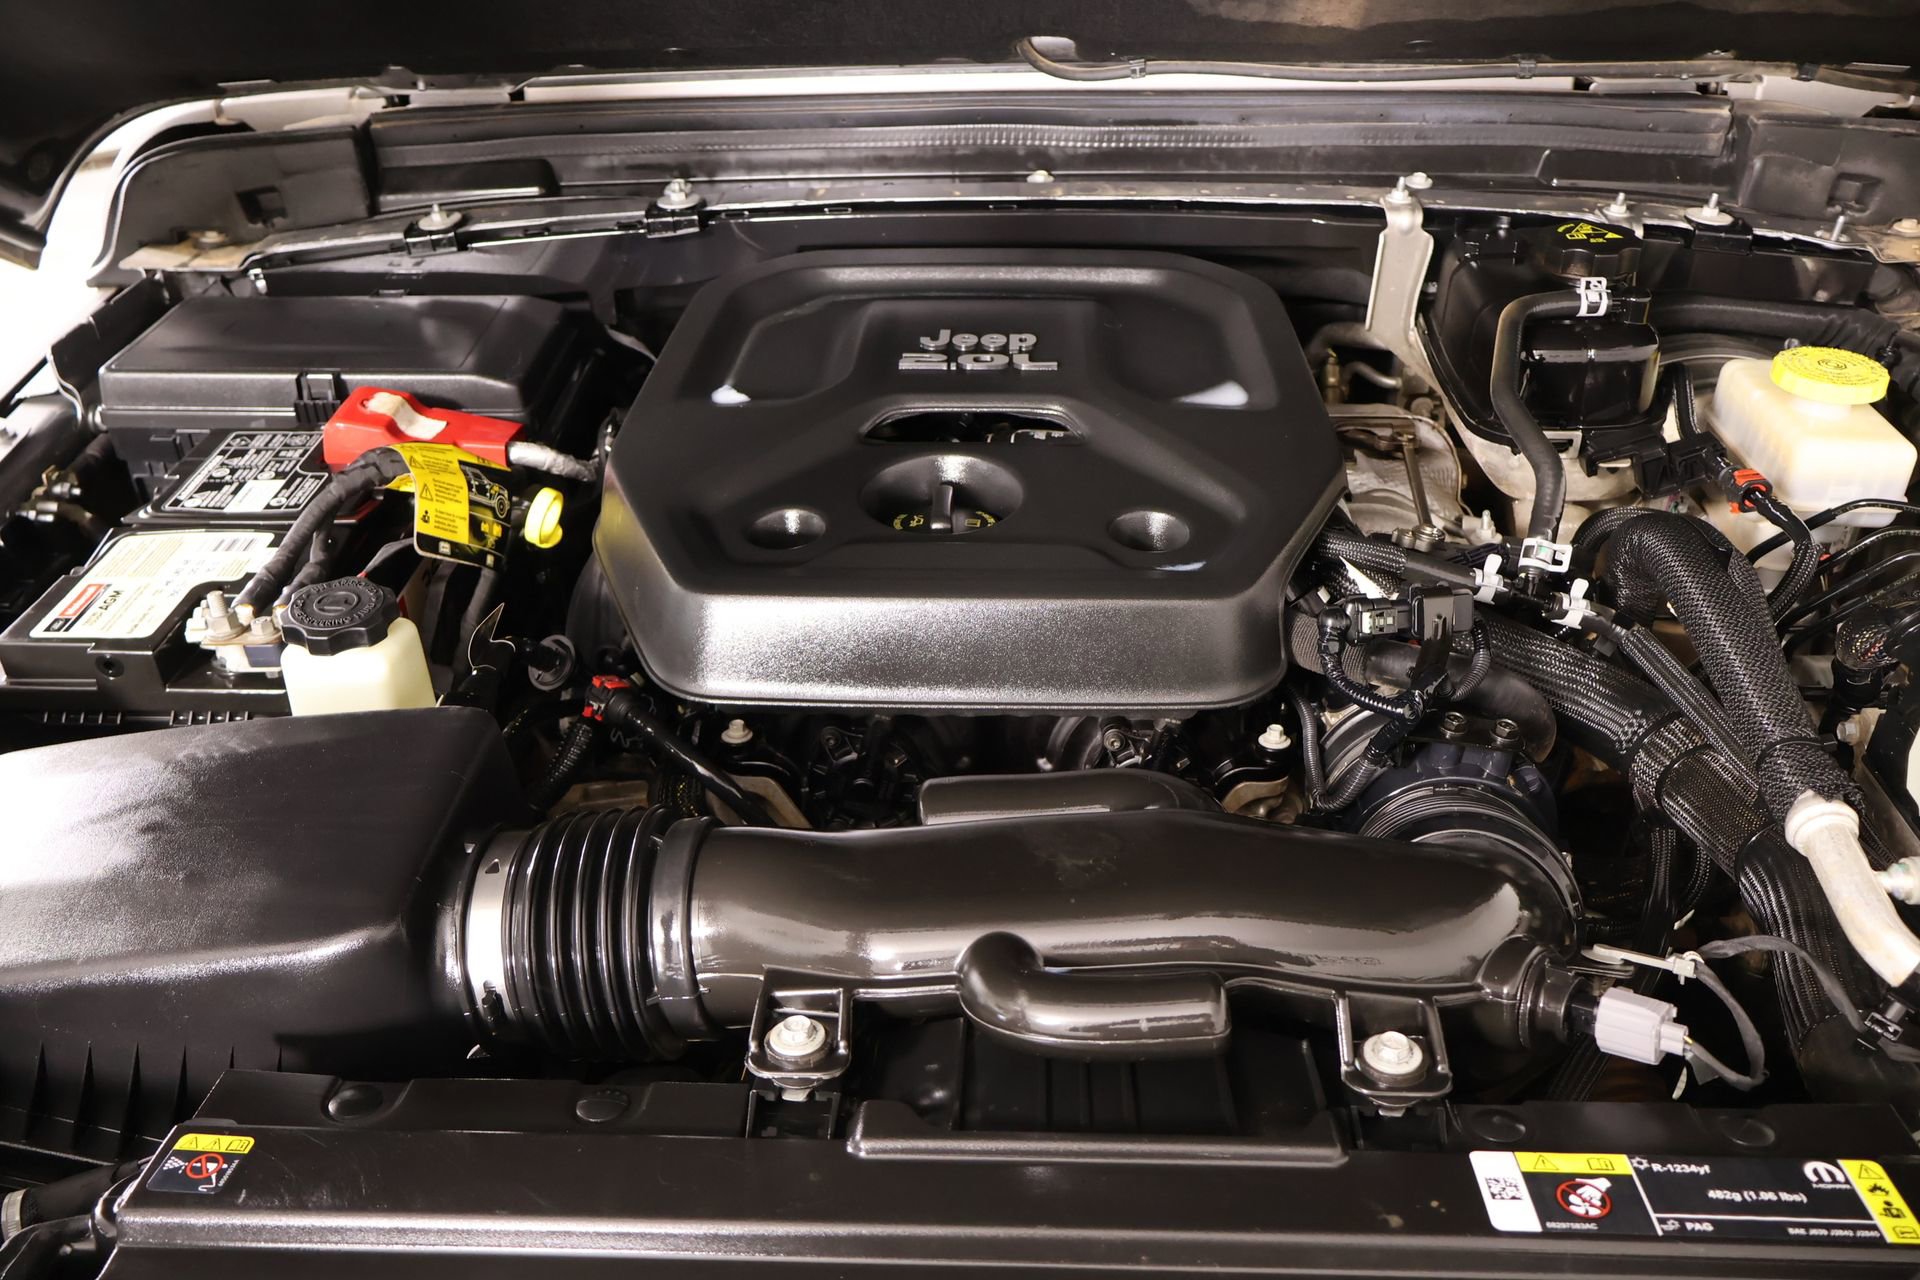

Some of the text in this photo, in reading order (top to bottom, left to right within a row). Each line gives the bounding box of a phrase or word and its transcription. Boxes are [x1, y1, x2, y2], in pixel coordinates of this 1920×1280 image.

[920, 329, 1037, 354] Jeep
[898, 353, 1058, 371] 2.0L
[101, 589, 124, 611] AGM
[1651, 1162, 1711, 1175] R-1234yf
[1684, 1221, 1714, 1232] PAG
